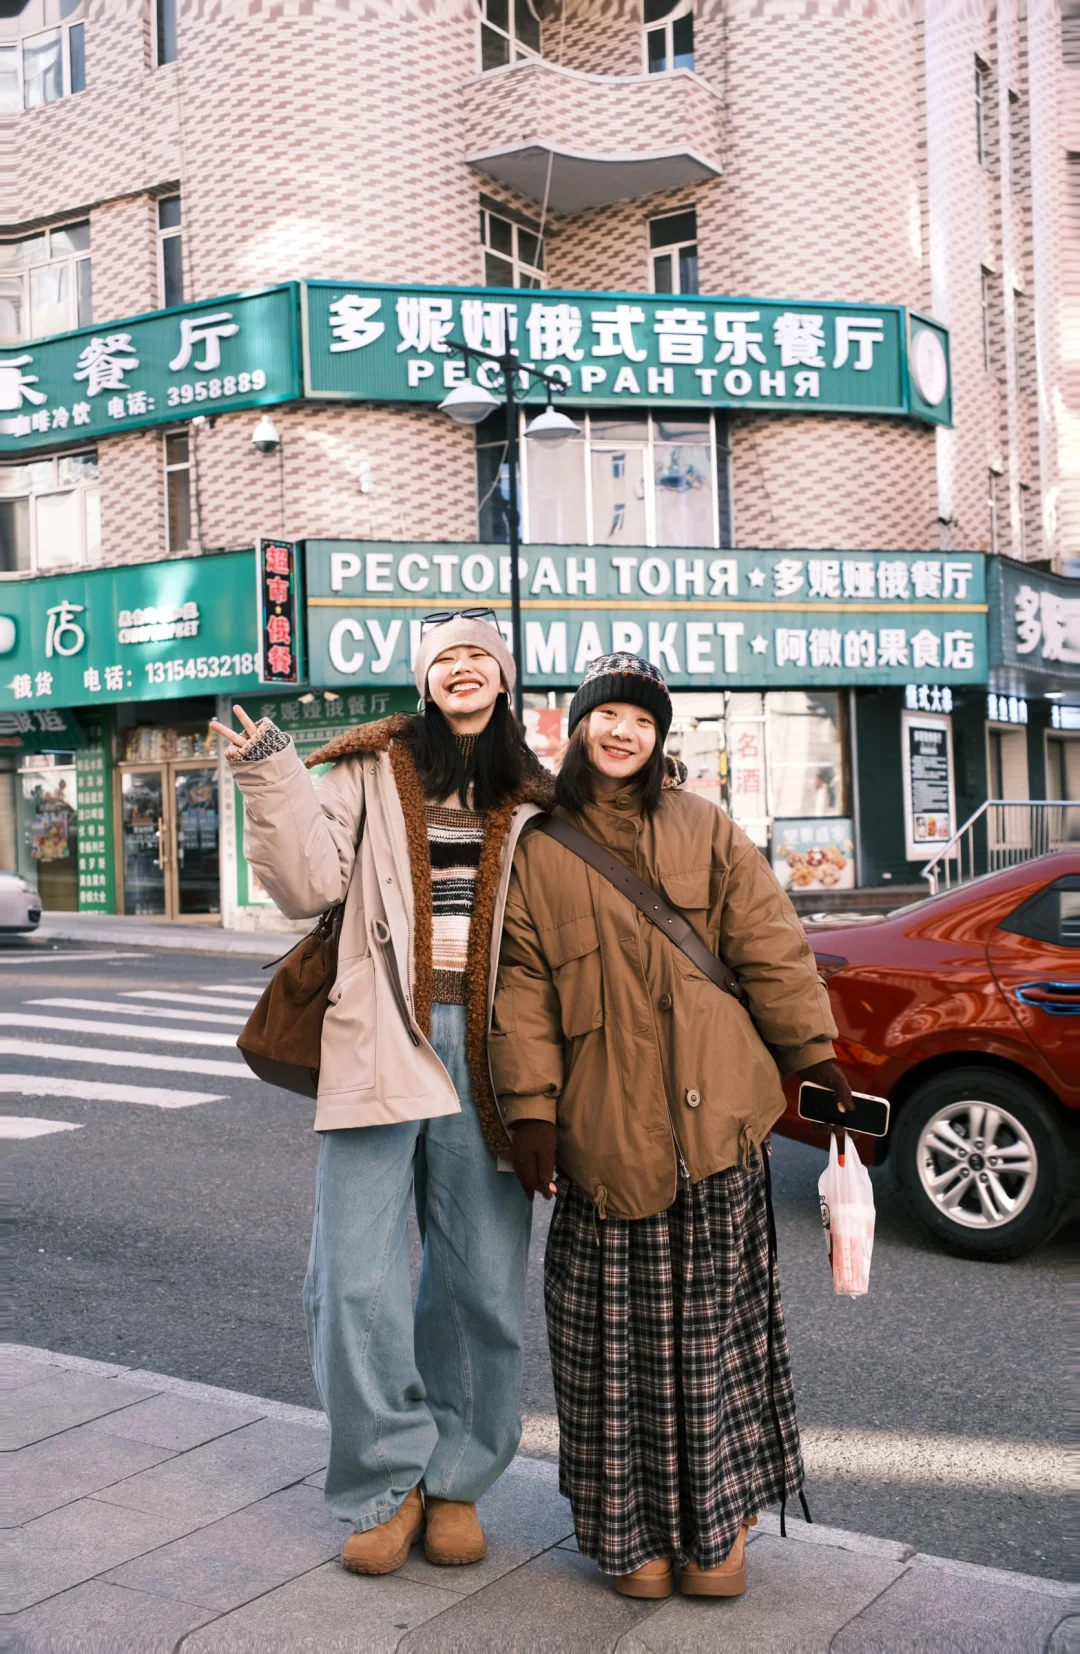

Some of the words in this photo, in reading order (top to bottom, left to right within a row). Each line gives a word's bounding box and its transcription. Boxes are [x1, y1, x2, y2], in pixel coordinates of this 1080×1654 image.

[329, 294, 884, 371] 多妮娅俄式音乐餐厅
[167, 369, 266, 407] 3958889
[407, 359, 674, 395] РЕСТОРАН
[695, 368, 820, 398] ТОНЯ
[331, 552, 596, 594] РЕСТОРАН
[612, 556, 738, 596] ТОНЯ
[773, 558, 973, 599] 多妮娅俄餐厅
[45, 600, 84, 657] 店
[329, 618, 744, 674] СУМАРКЕТ
[775, 628, 974, 669] 阿微的果食店
[737, 731, 761, 795] 名酒
